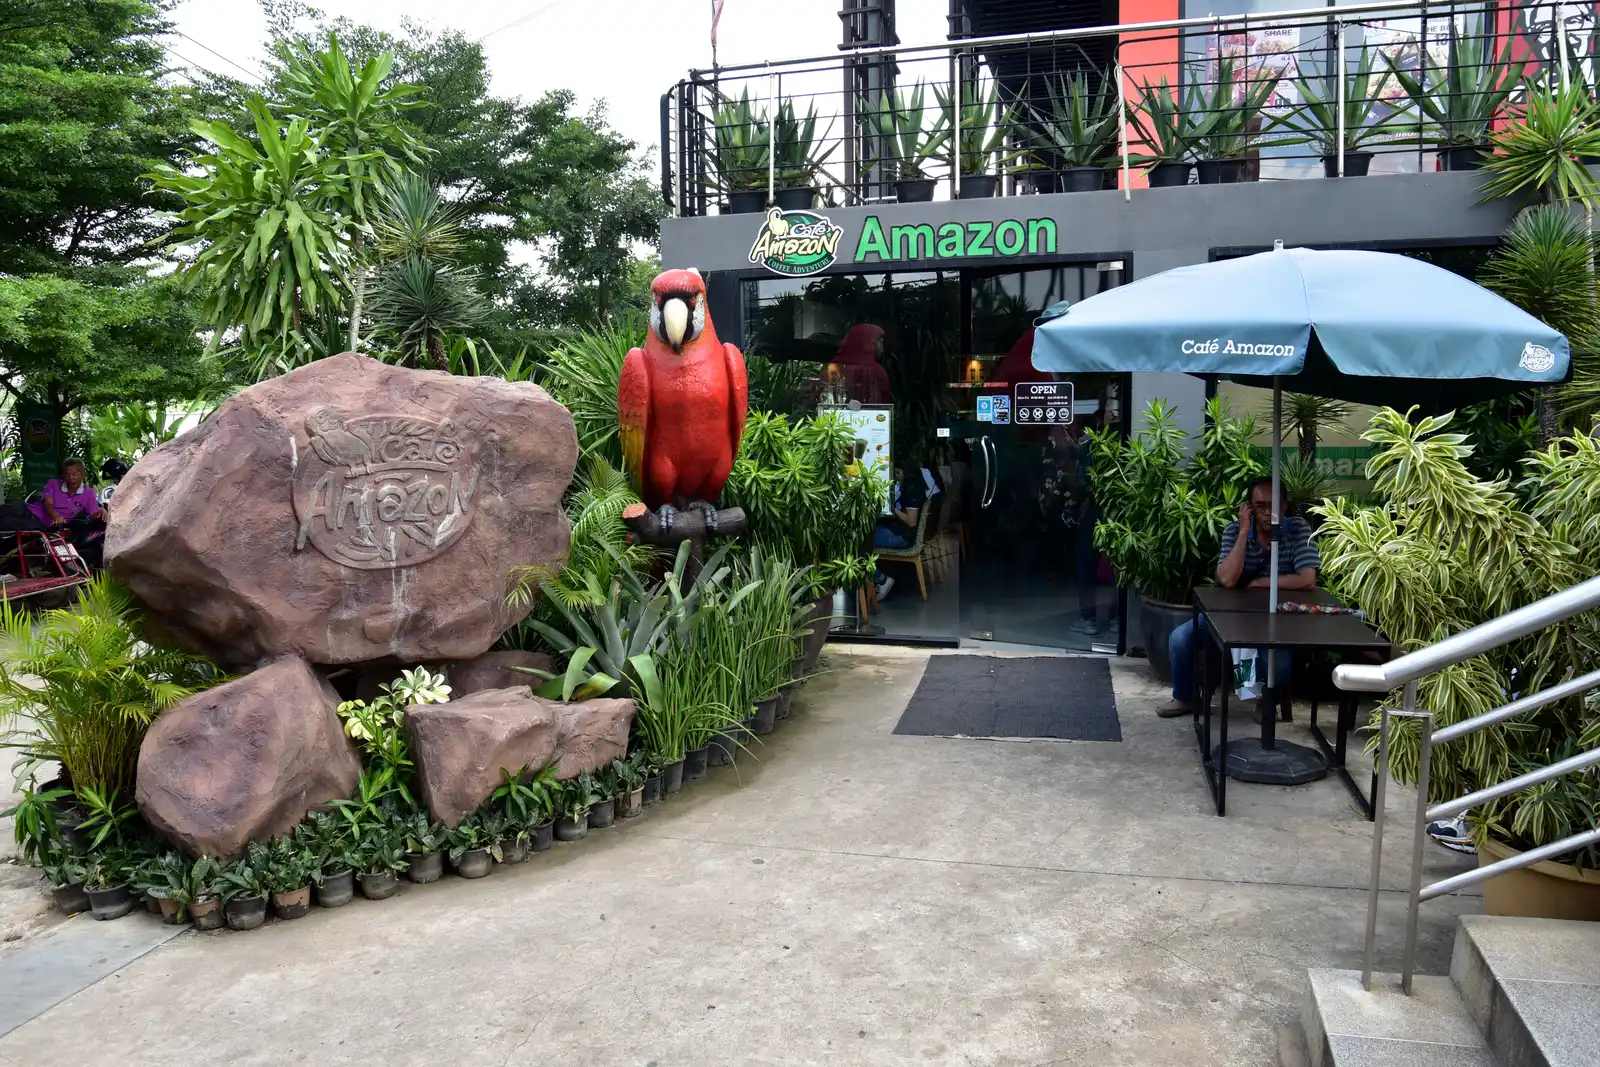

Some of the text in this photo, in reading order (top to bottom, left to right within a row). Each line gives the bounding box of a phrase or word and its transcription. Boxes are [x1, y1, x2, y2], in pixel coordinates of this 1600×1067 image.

[1264, 29, 1293, 37] SHARE
[854, 215, 1058, 262] Amazon
[1181, 338, 1295, 357] Café Amazon
[1030, 385, 1057, 394] OPEN
